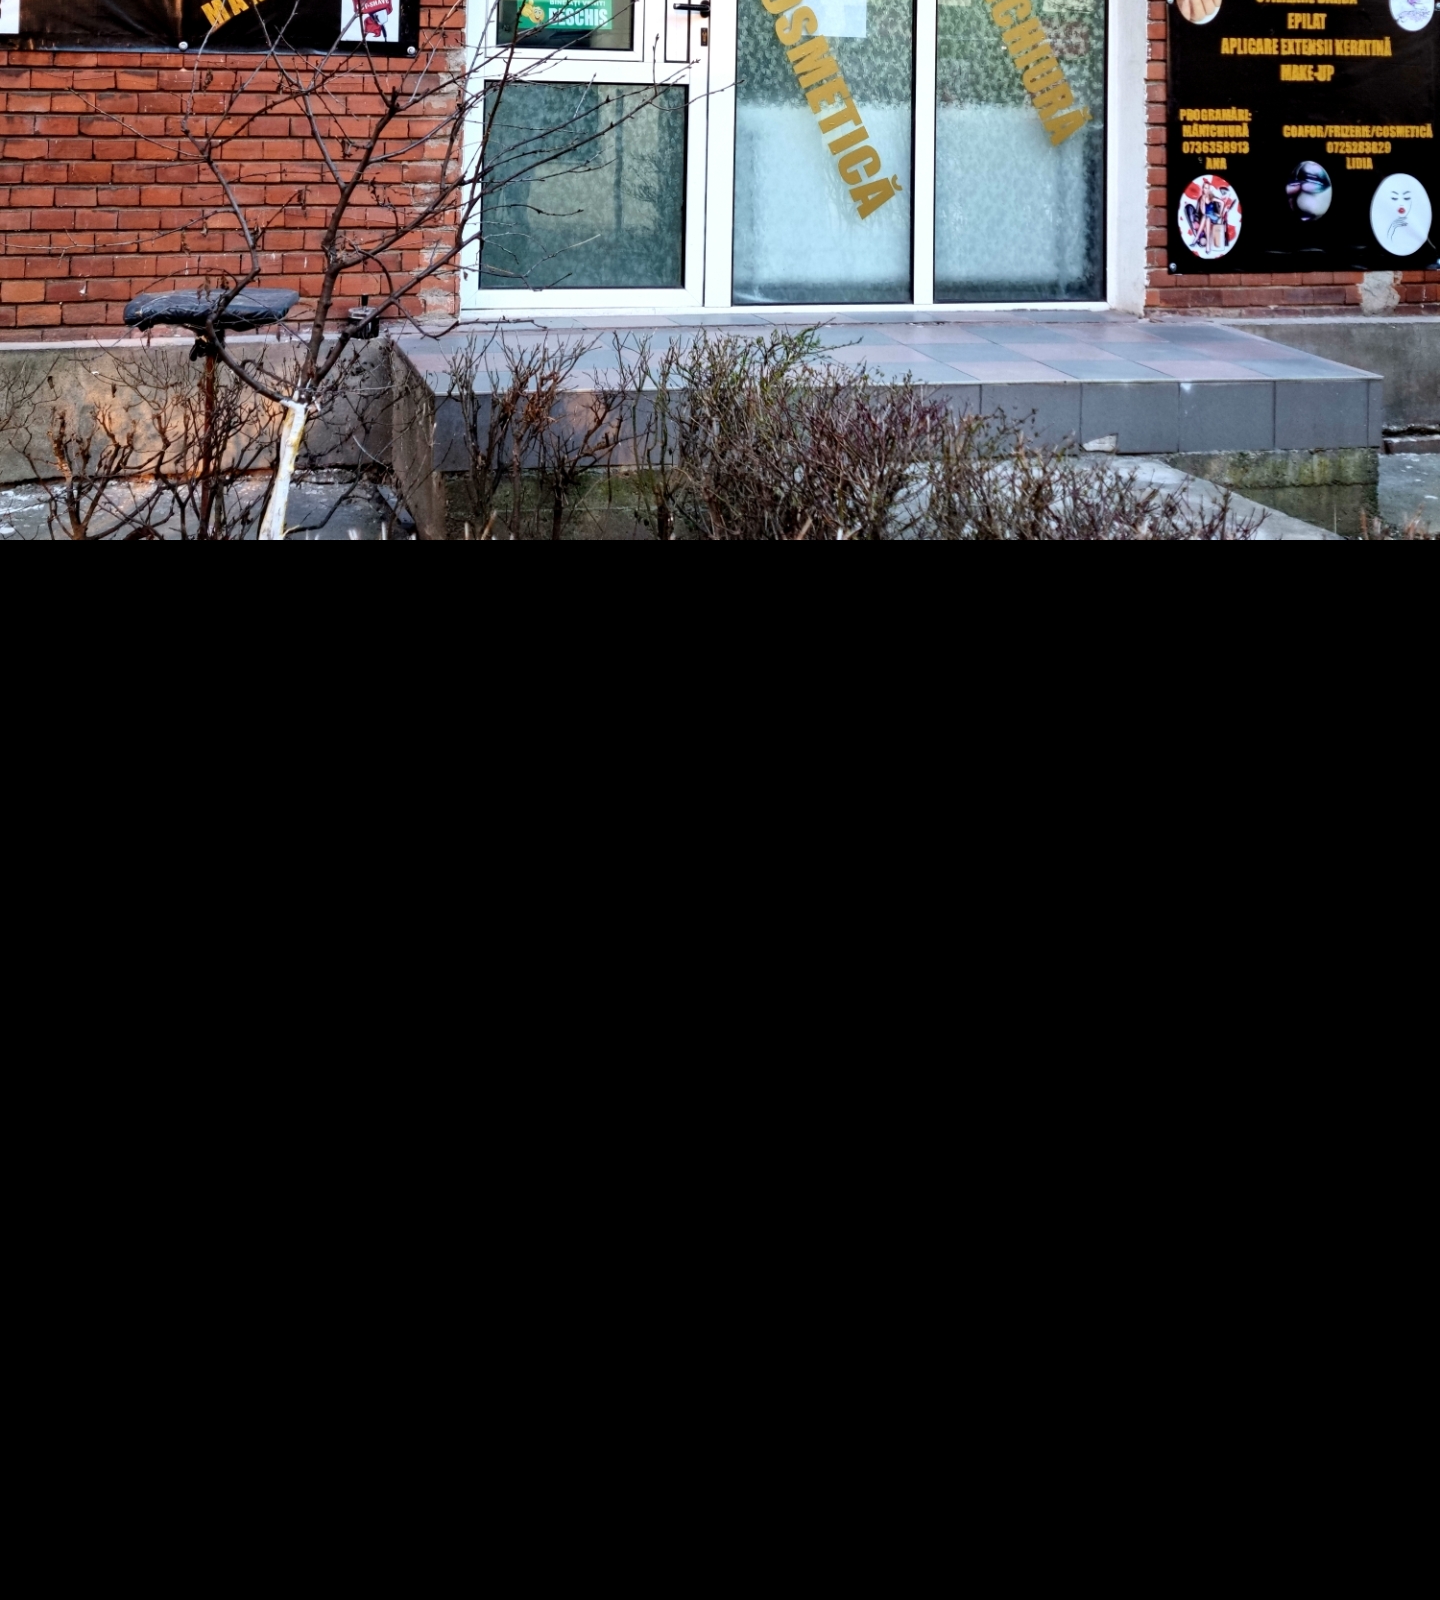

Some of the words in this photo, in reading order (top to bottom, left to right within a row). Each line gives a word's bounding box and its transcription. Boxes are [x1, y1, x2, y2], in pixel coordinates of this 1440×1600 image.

[548, 8, 609, 27] DESCHIS
[1287, 12, 1327, 30] EPILAT
[1221, 37, 1279, 55] APLICARE
[1280, 38, 1333, 56] EXTENSII
[1334, 36, 1392, 57] KERATINĂ
[1280, 64, 1335, 82] MAKE-UP
[1205, 156, 1227, 170] ANA
[1345, 156, 1373, 170] LIDIA
